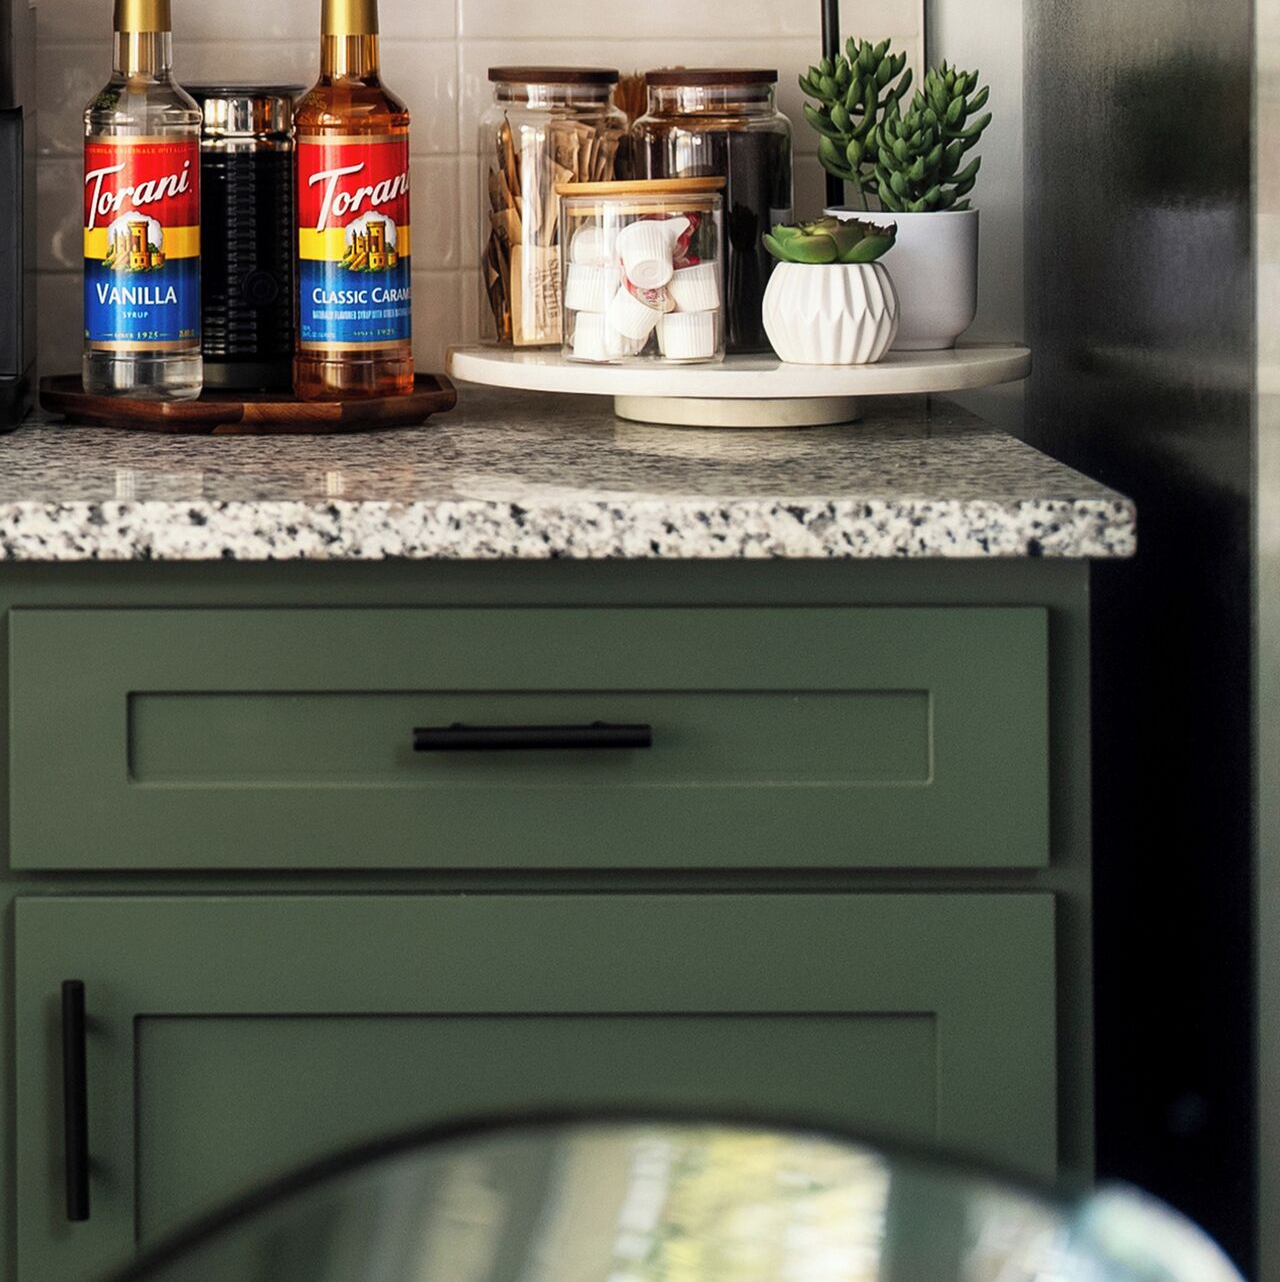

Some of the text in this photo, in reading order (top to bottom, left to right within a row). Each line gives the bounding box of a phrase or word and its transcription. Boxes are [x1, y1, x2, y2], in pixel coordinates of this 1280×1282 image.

[85, 160, 191, 231] Torani
[308, 161, 409, 233] Toran
[96, 282, 178, 306] VANILLA
[312, 287, 369, 305] CLASSIC
[122, 311, 149, 319] SYRUP
[137, 331, 159, 340] 1925
